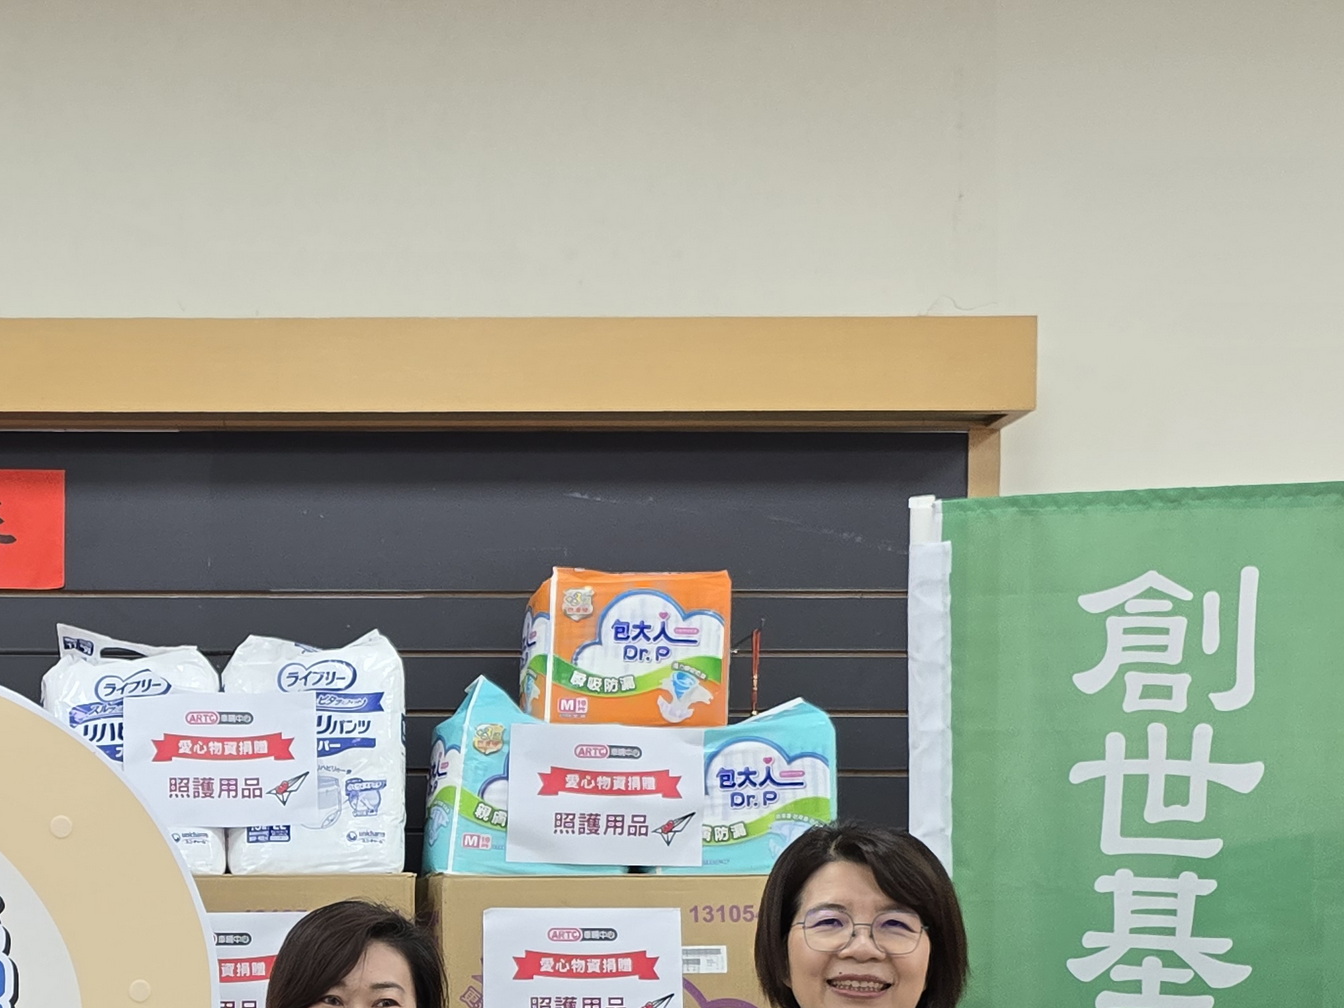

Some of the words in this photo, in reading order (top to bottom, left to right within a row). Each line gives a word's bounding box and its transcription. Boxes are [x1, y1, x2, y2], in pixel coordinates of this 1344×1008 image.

[612, 617, 698, 644] 包大人
[624, 645, 651, 661] Dr.
[656, 645, 671, 661] P
[103, 678, 162, 697] ライフリー
[560, 699, 575, 711] M
[189, 714, 216, 722] ARTC
[177, 740, 269, 755] 愛心物資捐贈
[578, 746, 606, 756] ARTC
[564, 774, 656, 791] 愛心物資捐贈
[717, 764, 805, 789] 包大人
[168, 777, 263, 799] 照護用品
[731, 792, 758, 807] Dr.
[763, 791, 777, 806] P
[553, 813, 649, 837] 照護用品
[463, 835, 479, 847] M
[689, 905, 758, 924] 13105
[551, 930, 578, 940] ARTC
[539, 957, 634, 974] 愛心物資捐贈
